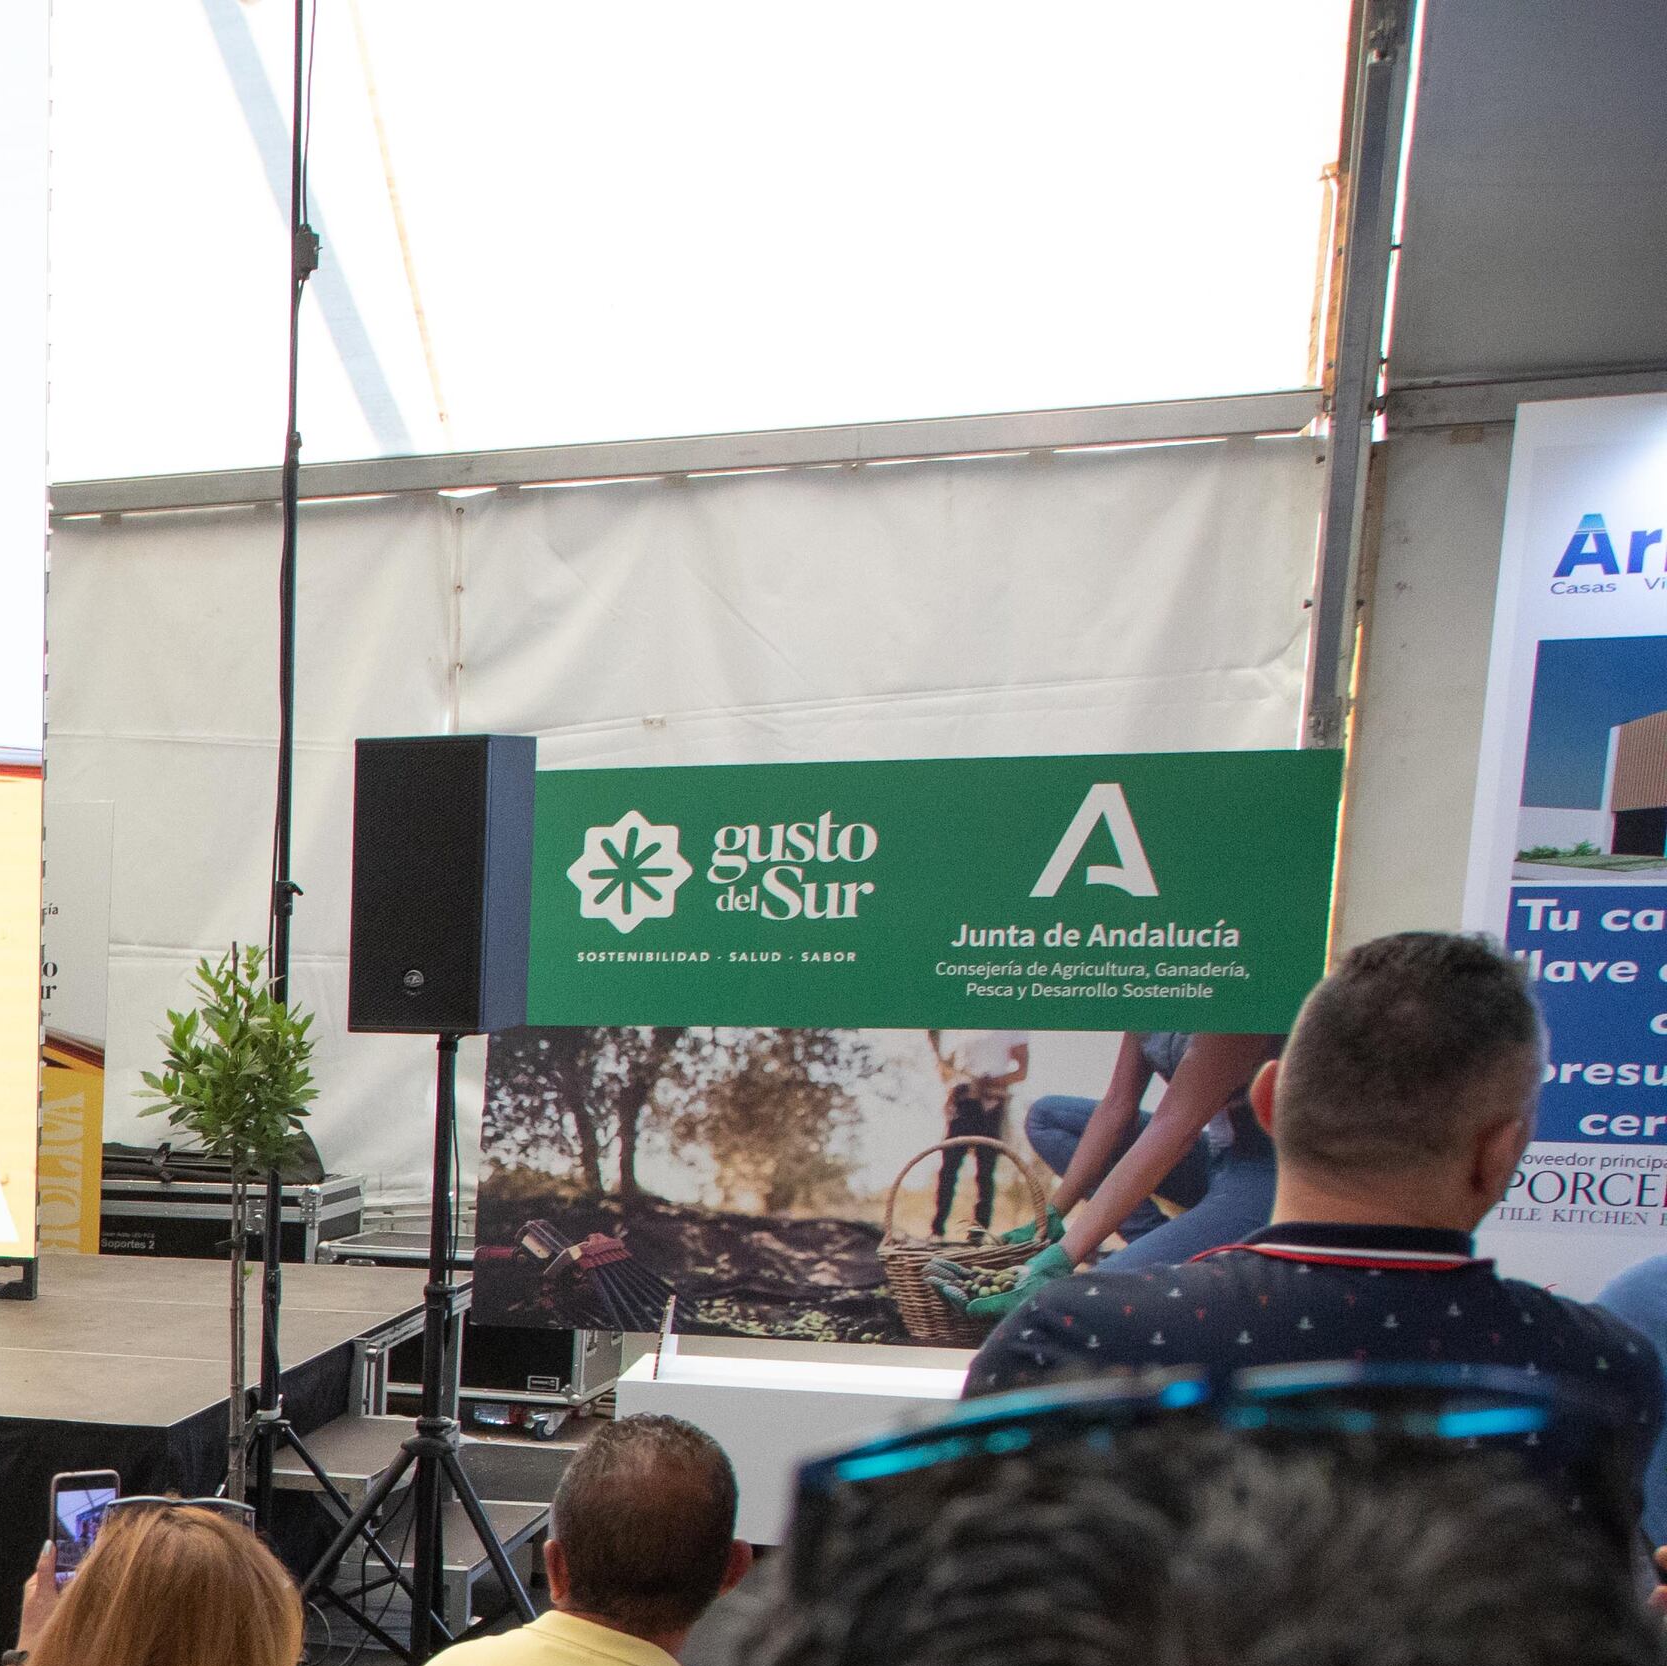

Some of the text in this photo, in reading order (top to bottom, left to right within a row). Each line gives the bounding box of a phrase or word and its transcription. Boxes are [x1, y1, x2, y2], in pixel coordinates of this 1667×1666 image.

[1552, 513, 1667, 578] Ar
[1550, 581, 1617, 595] Casas
[706, 810, 879, 884] gusto
[716, 865, 875, 920] del Sur
[1517, 898, 1666, 932] Tu ca
[951, 919, 1240, 948] Junta de Andalucía
[577, 951, 857, 962] SOSTENIBILIDAD SALUD SABOR
[935, 960, 1250, 980] Consejería de Agricultura, Ganadería,
[967, 982, 1214, 1001] Pesca y Desarrollo Sostenible
[1579, 1113, 1666, 1137] cer
[1500, 1170, 1667, 1208] PORCE
[1496, 1206, 1541, 1222] TILE
[1553, 1208, 1648, 1226] KITCHEN
[101, 1239, 155, 1250] Soportes 2
